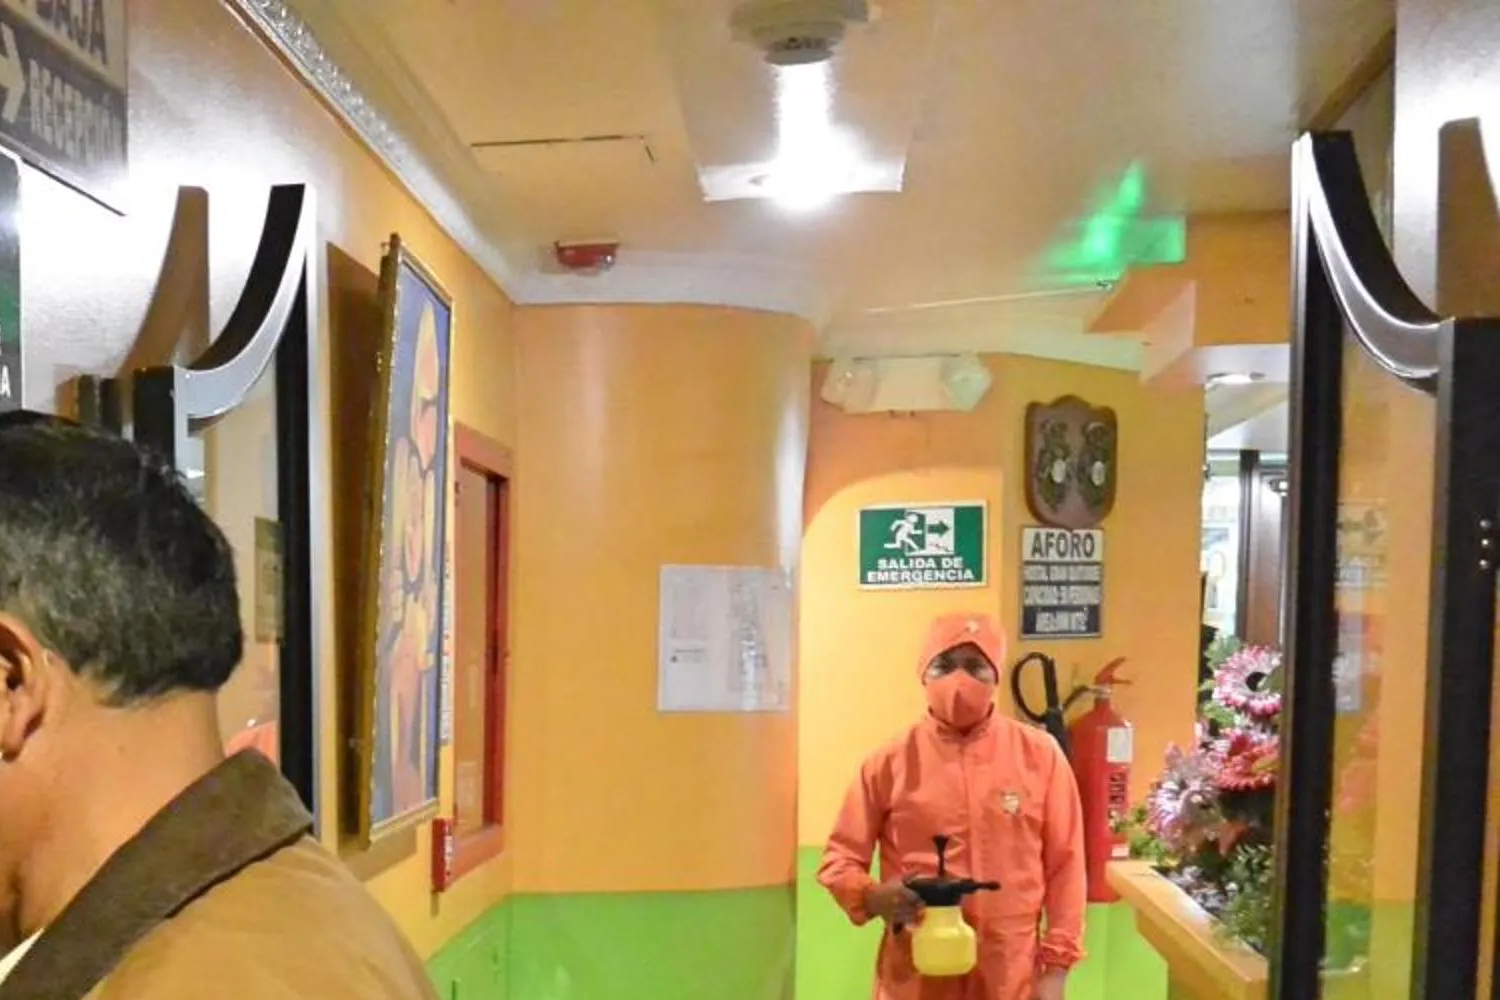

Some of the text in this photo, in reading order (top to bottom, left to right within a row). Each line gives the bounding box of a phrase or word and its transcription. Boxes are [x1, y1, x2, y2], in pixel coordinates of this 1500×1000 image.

[1031, 531, 1095, 558] AFORO
[877, 556, 964, 570] SALIDA DE
[866, 568, 974, 583] EMERGENCIA
